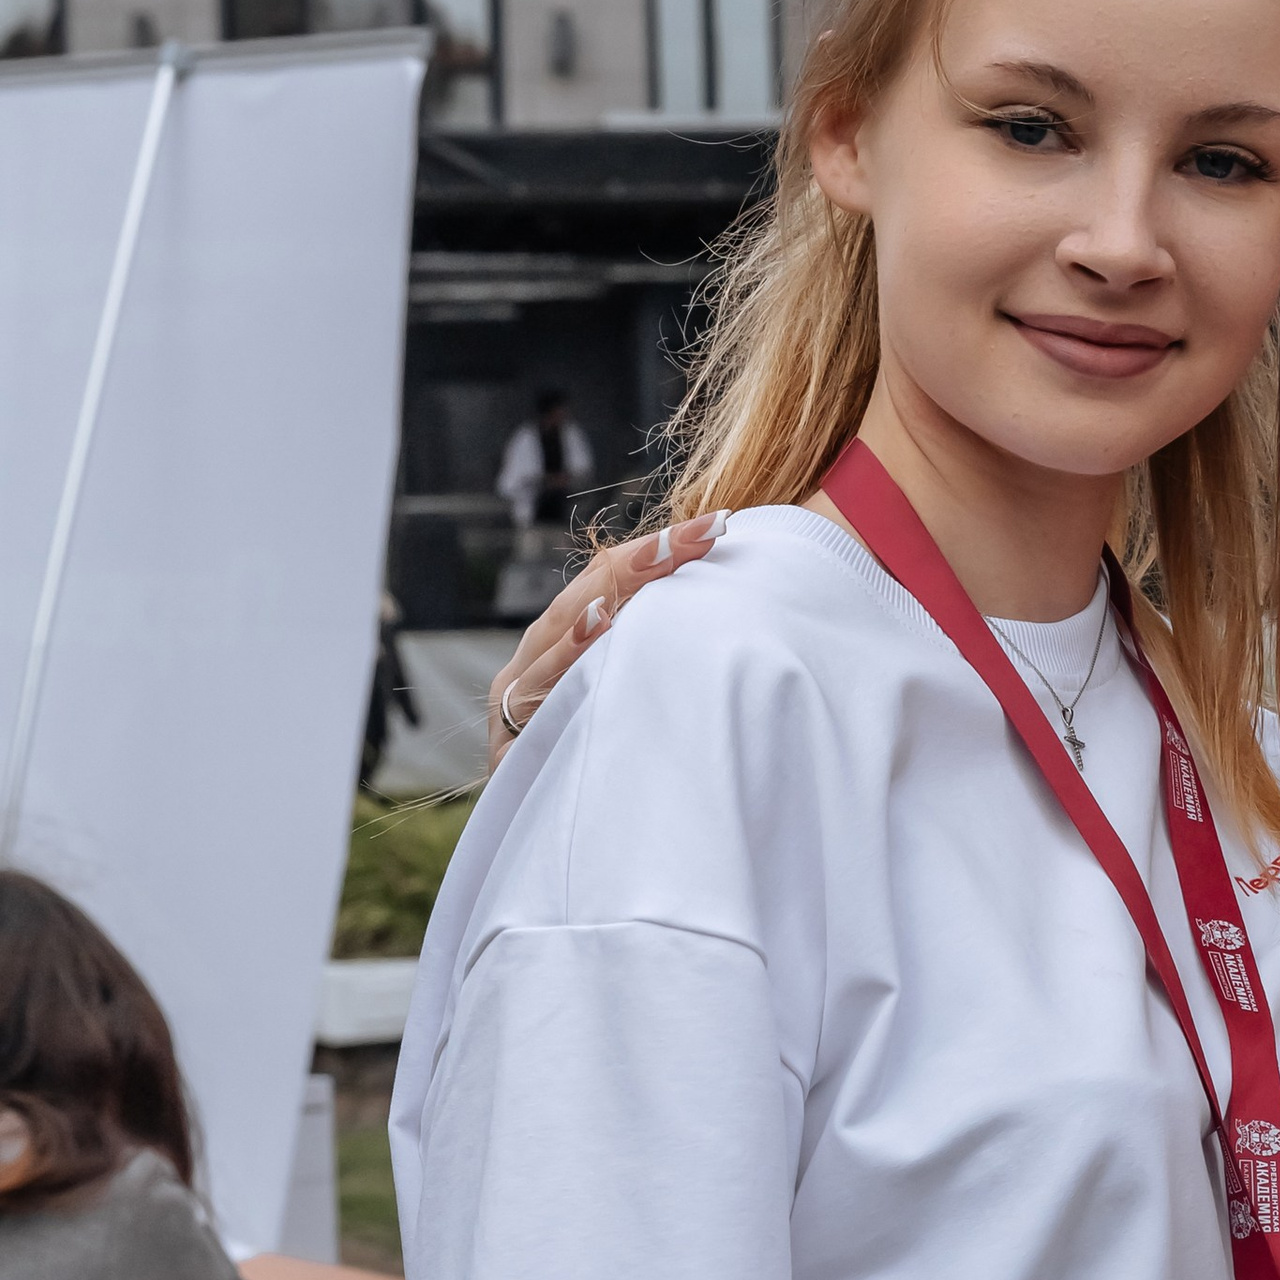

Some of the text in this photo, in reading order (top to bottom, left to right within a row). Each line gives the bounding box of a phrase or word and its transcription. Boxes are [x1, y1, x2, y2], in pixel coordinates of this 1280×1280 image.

[1179, 755, 1198, 821] АКАДЕМИЯ
[1222, 952, 1252, 1011] АКАДЕМИЯ
[1235, 953, 1259, 1013] ПРЕЗИДЕНТСКАЯ
[1256, 1160, 1272, 1233] АКАДЕМИЯ
[1270, 1160, 1280, 1233] ПРЕЗИДЕНТСКАЯ
